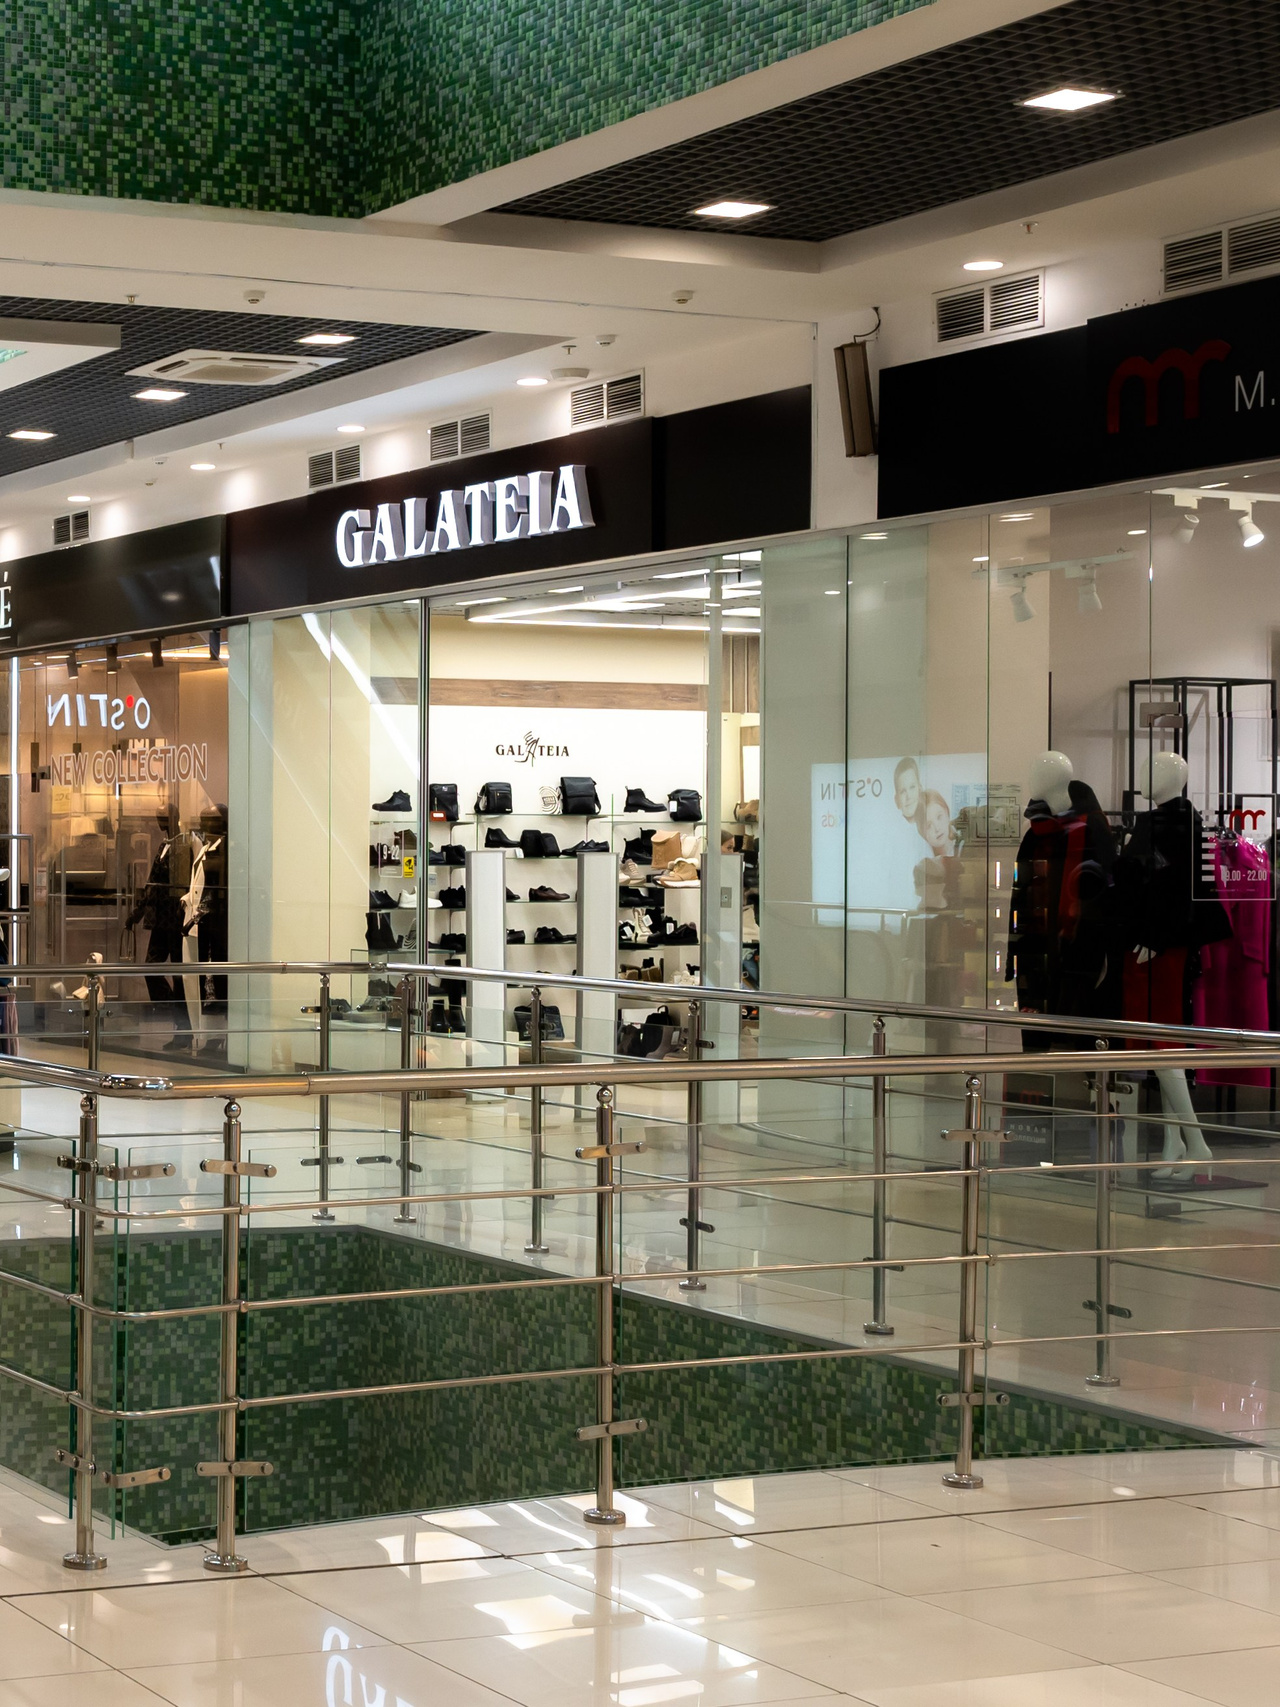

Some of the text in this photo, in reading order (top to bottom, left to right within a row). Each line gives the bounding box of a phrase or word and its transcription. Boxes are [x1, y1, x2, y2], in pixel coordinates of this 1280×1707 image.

[335, 464, 596, 568] GALATEIA
[51, 743, 209, 788] NEW COLLECTION
[495, 731, 570, 767] GALATEIA
[1247, 869, 1267, 882] 22.00
